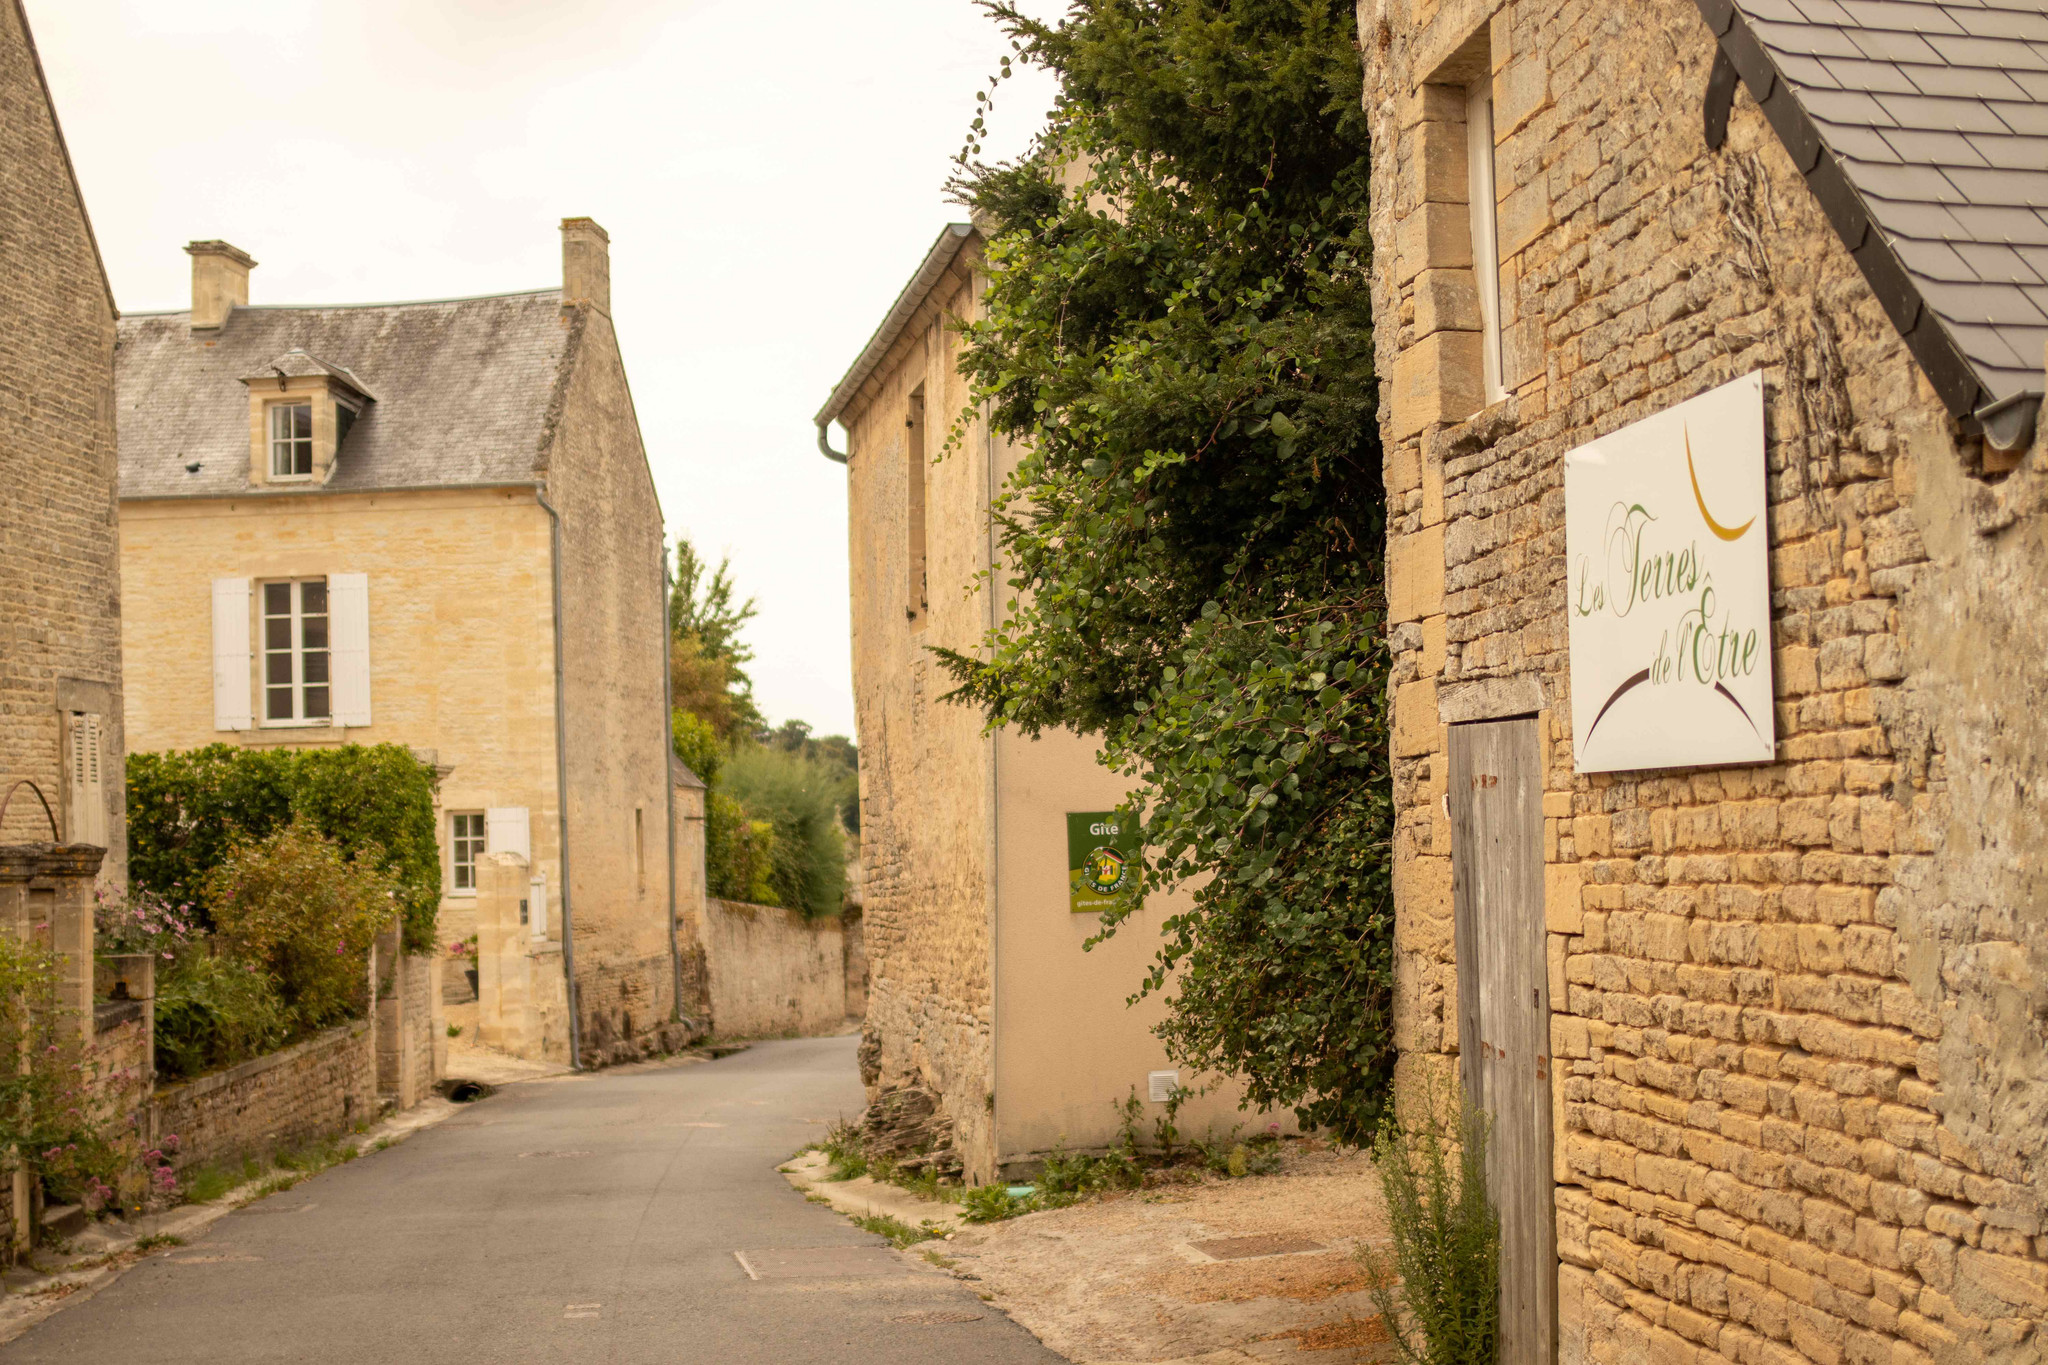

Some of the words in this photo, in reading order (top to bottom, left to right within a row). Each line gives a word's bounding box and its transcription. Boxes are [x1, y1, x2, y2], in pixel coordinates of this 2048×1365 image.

[1574, 552, 1605, 617] Les
[1604, 501, 1704, 618] Terres
[1652, 629, 1673, 685] de
[1090, 822, 1119, 836] Gîte
